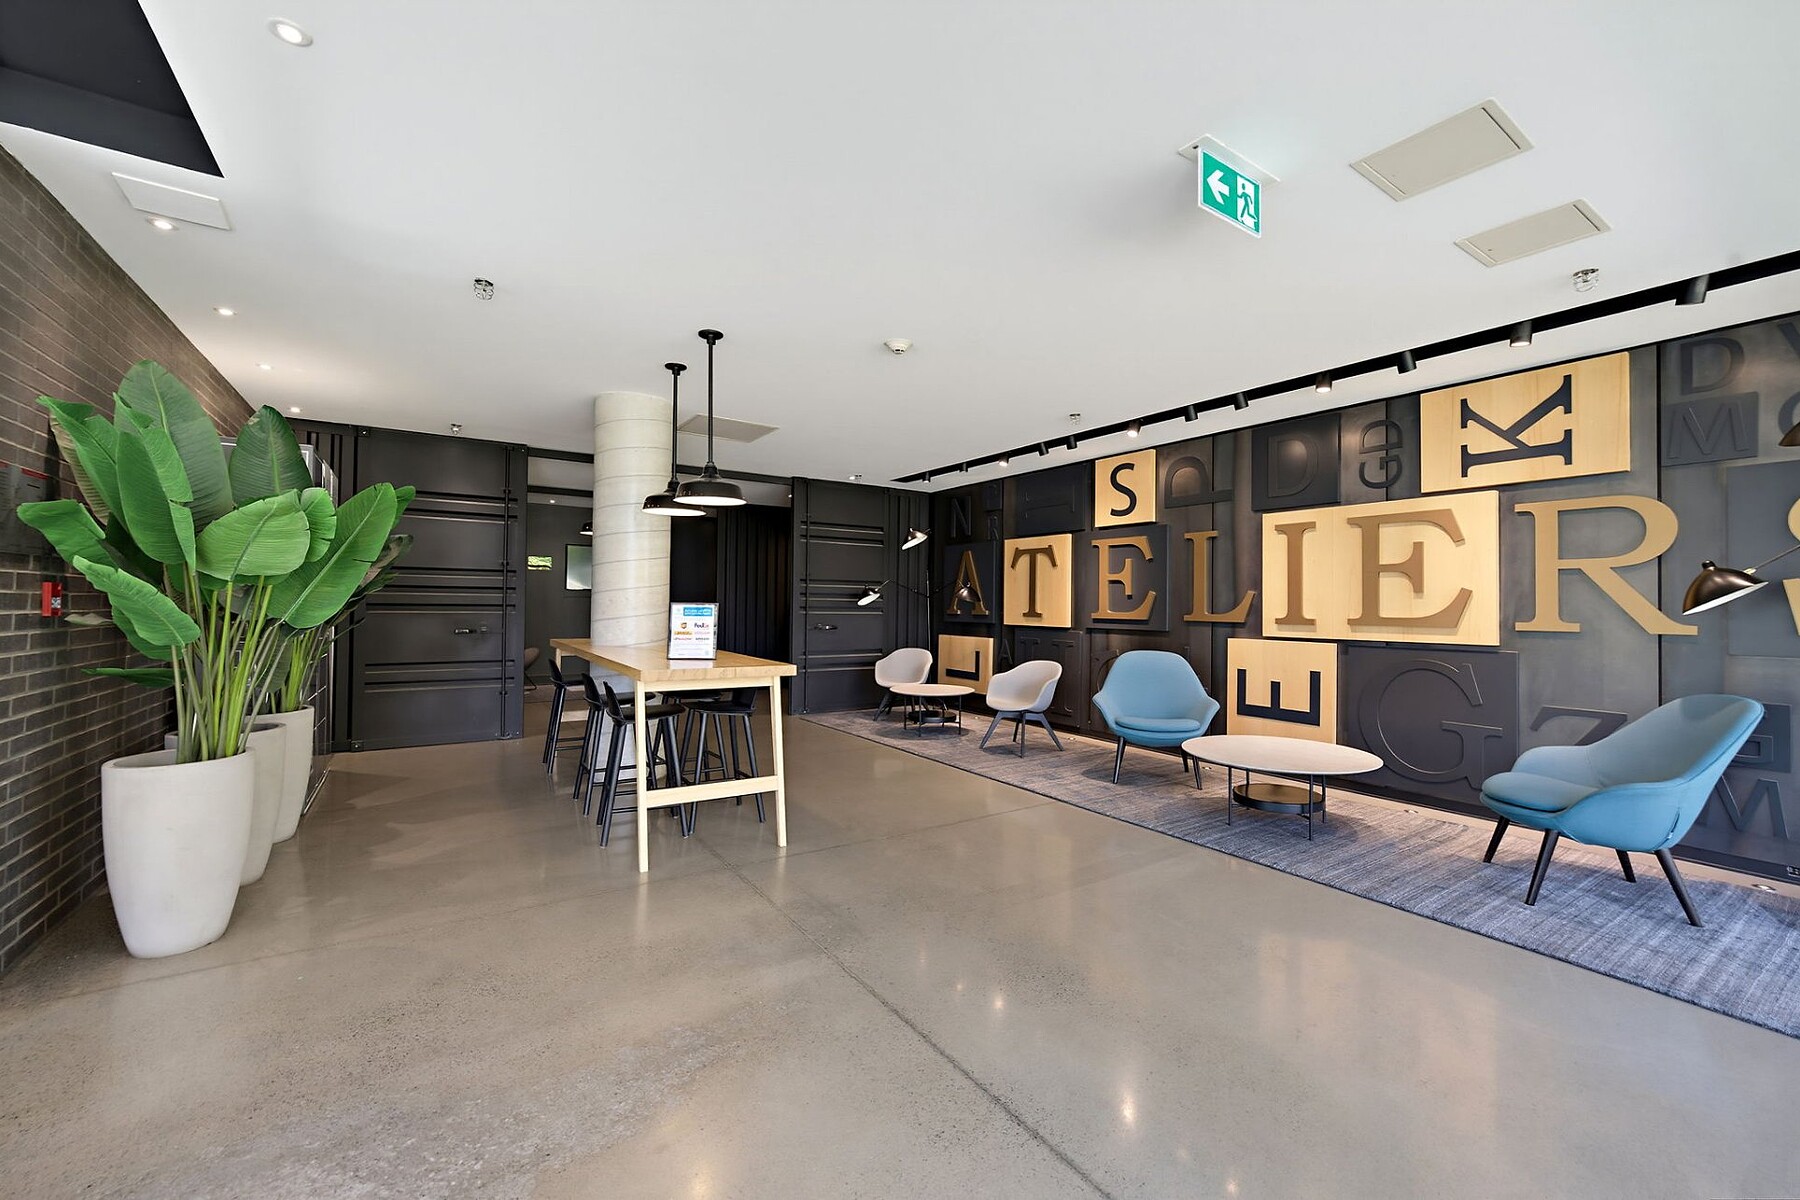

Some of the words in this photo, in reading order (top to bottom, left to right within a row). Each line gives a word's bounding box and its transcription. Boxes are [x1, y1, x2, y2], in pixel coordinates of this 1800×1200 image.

[1460, 374, 1573, 478] K
[1109, 462, 1136, 517] S
[946, 494, 1800, 636] ATELIER
[1236, 668, 1321, 727] E
